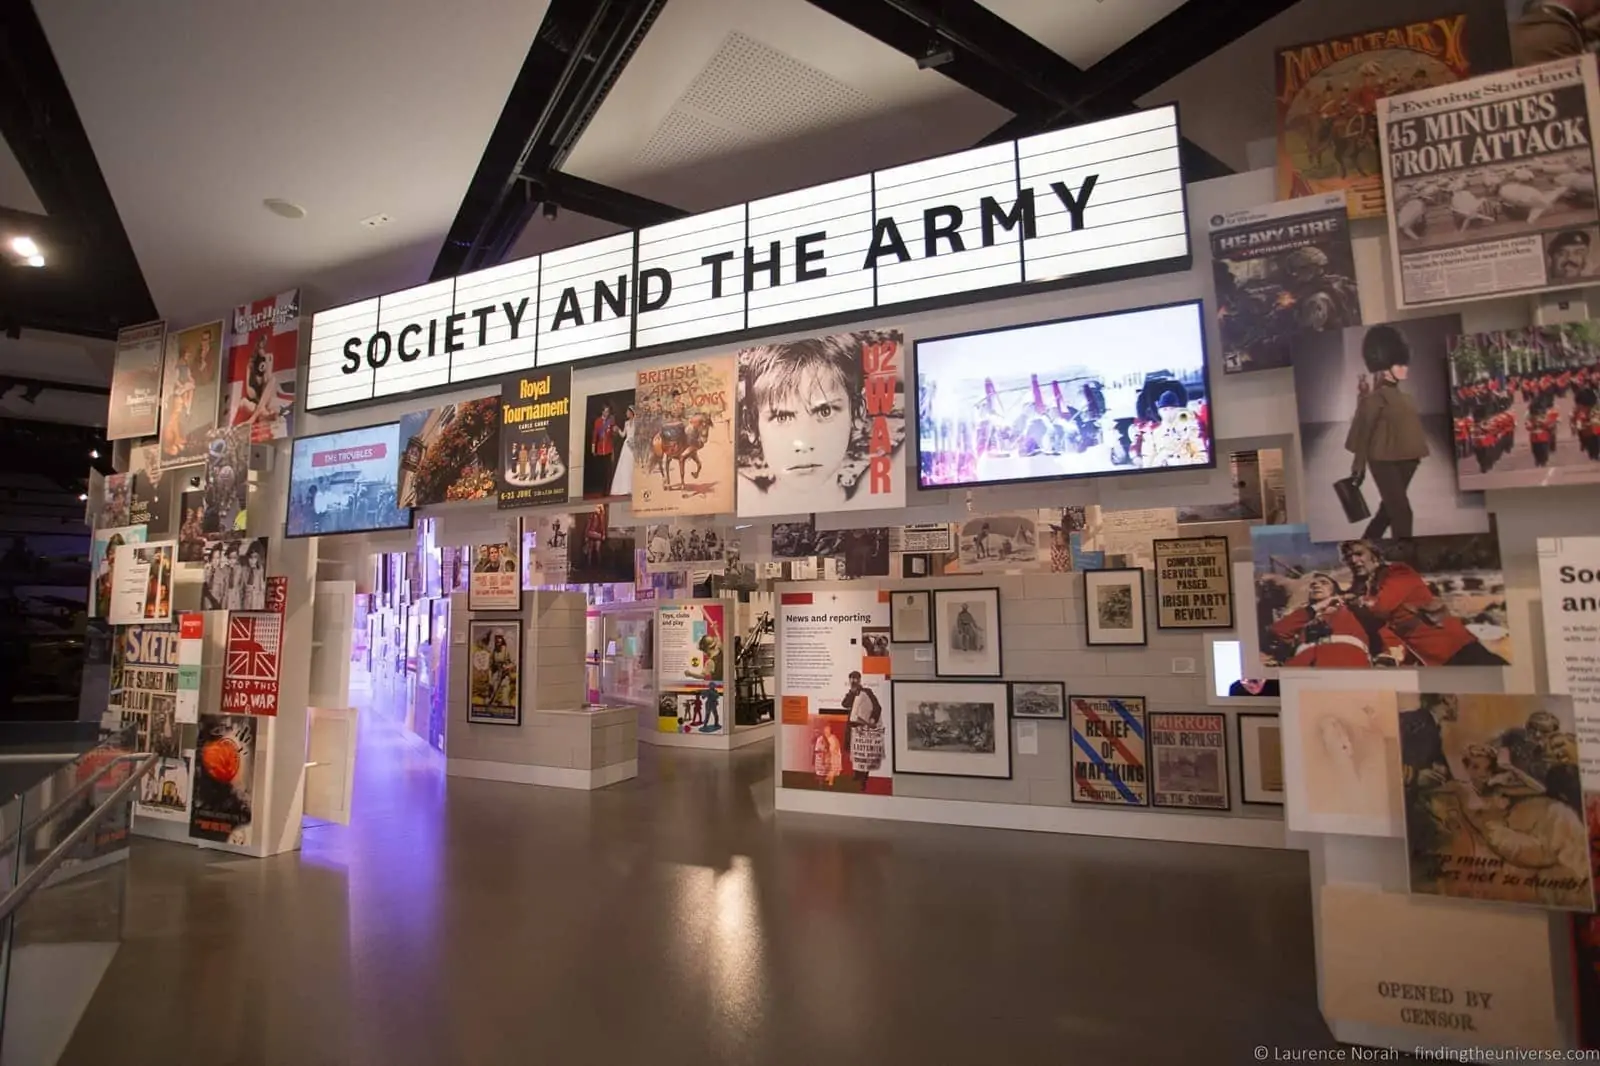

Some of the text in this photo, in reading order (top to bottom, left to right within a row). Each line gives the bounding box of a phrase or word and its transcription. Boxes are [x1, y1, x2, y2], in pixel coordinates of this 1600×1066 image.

[1280, 14, 1470, 102] MILITARY
[1400, 88, 1481, 113] Evening
[1483, 63, 1583, 97] Standard
[1389, 93, 1557, 151] 45 MINUTES
[1391, 116, 1588, 179] FROM ATTACK
[1220, 218, 1338, 250] HEAVY FIRE
[341, 174, 1100, 375] SOCIETY AND THE ARMY
[861, 340, 897, 374] U2
[639, 364, 697, 385] BRITISH
[520, 375, 551, 400] Royal
[649, 379, 699, 397] ARMY
[688, 389, 727, 412] SONGS
[503, 397, 569, 424] Tournament
[864, 376, 896, 495] WAR
[1166, 556, 1216, 568] COMPULSORY
[1162, 566, 1223, 580] SERVICE BILL
[1162, 593, 1227, 608] IRISH PARTY
[1562, 596, 1600, 612] an
[786, 612, 872, 624] News and reporting
[1174, 608, 1217, 621] REVOLT.
[225, 680, 277, 692] STOP THIS
[223, 693, 276, 709] MAD WAR
[1085, 719, 1130, 738] RELIEF
[1154, 715, 1220, 730] MIRROR
[1153, 730, 1222, 748] HUNS REPULSED
[1101, 741, 1115, 759] OF
[1457, 855, 1504, 868] mum
[1468, 870, 1496, 885] not
[1502, 874, 1520, 886] so
[1378, 980, 1493, 1010] OPENED BY
